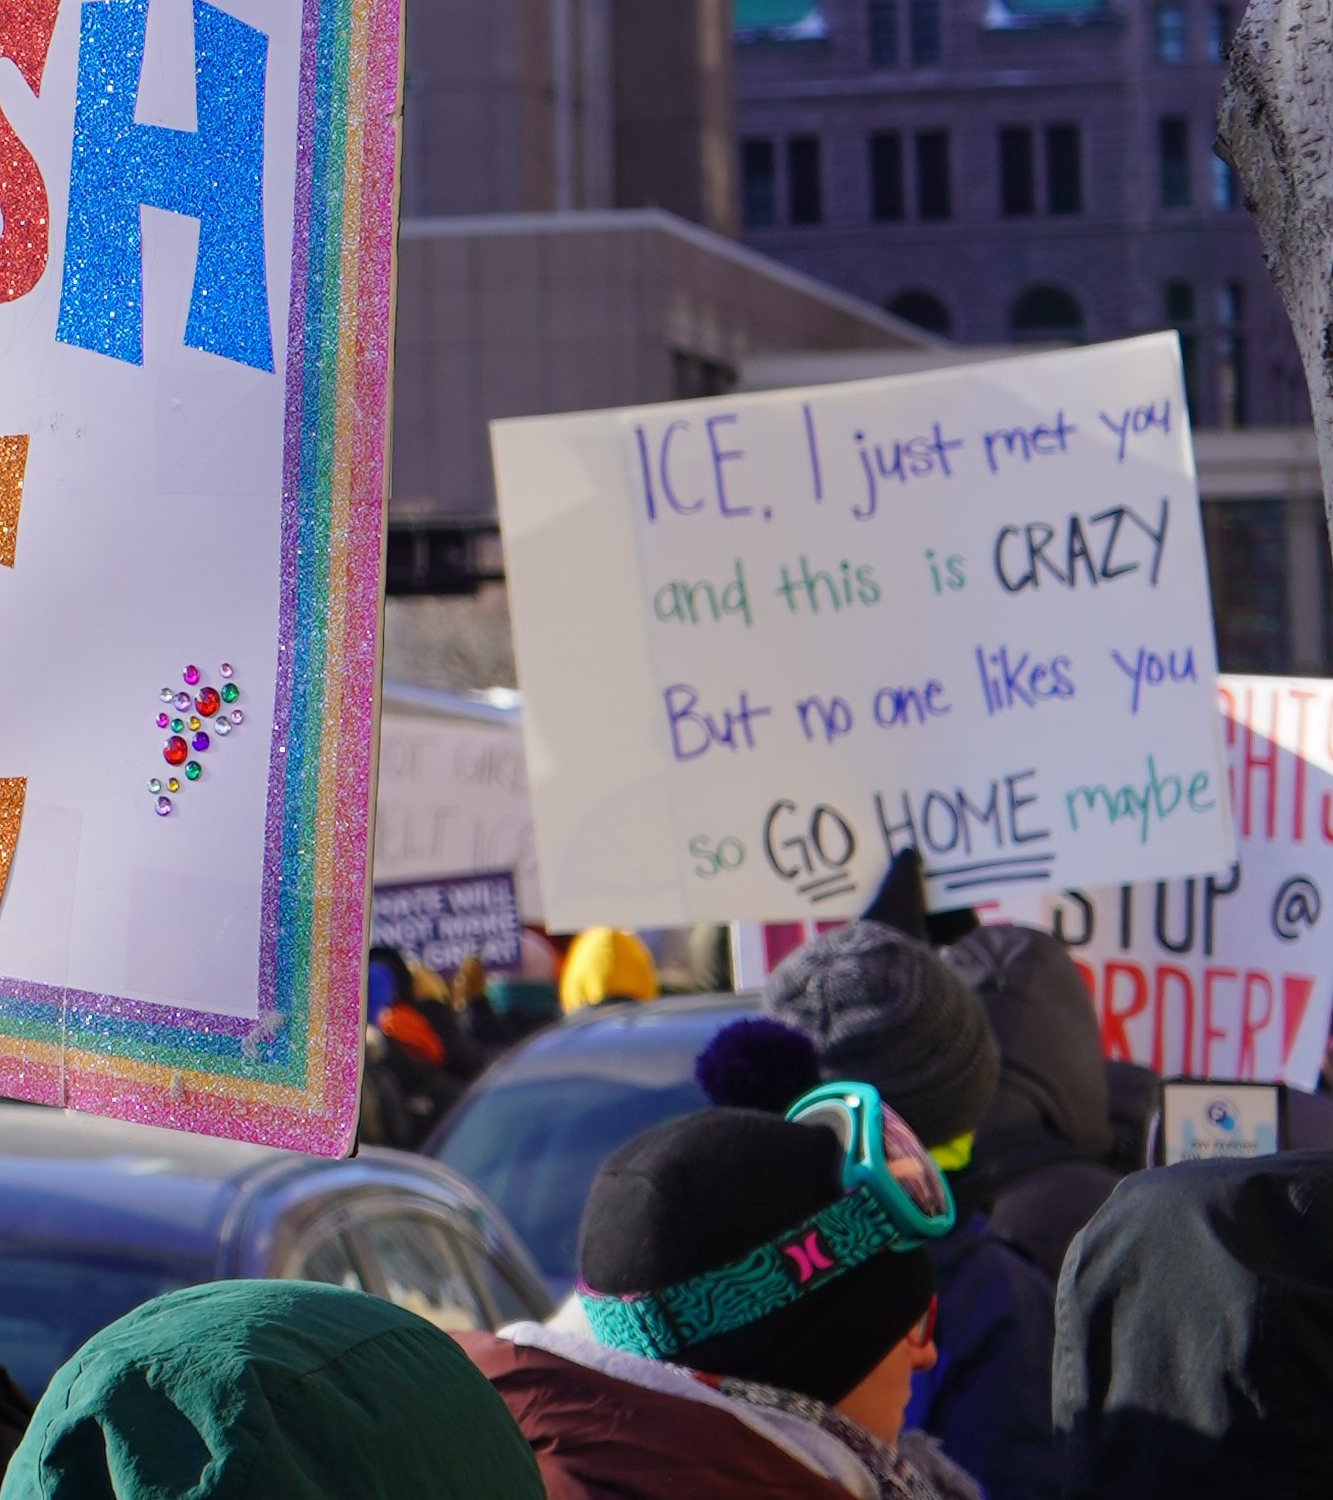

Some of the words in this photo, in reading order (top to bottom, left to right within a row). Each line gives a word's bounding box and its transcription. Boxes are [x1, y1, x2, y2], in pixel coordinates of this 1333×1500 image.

[802, 402, 823, 502] I
[852, 421, 965, 521] just
[982, 409, 1078, 473] met
[1098, 399, 1171, 462] you
[652, 556, 754, 628] and
[775, 554, 882, 616] this
[924, 548, 966, 595] is
[993, 495, 1170, 595] CRAZY
[662, 683, 773, 762] But
[795, 695, 853, 745] no
[873, 679, 953, 726] one
[974, 643, 1077, 717] likes
[1111, 645, 1197, 716] you
[688, 834, 746, 880] so
[762, 797, 857, 880] GO
[873, 767, 1051, 861] HOME
[1063, 753, 1218, 846] maybe
[1270, 874, 1322, 940] @
[1074, 961, 1315, 1078] RDER!
